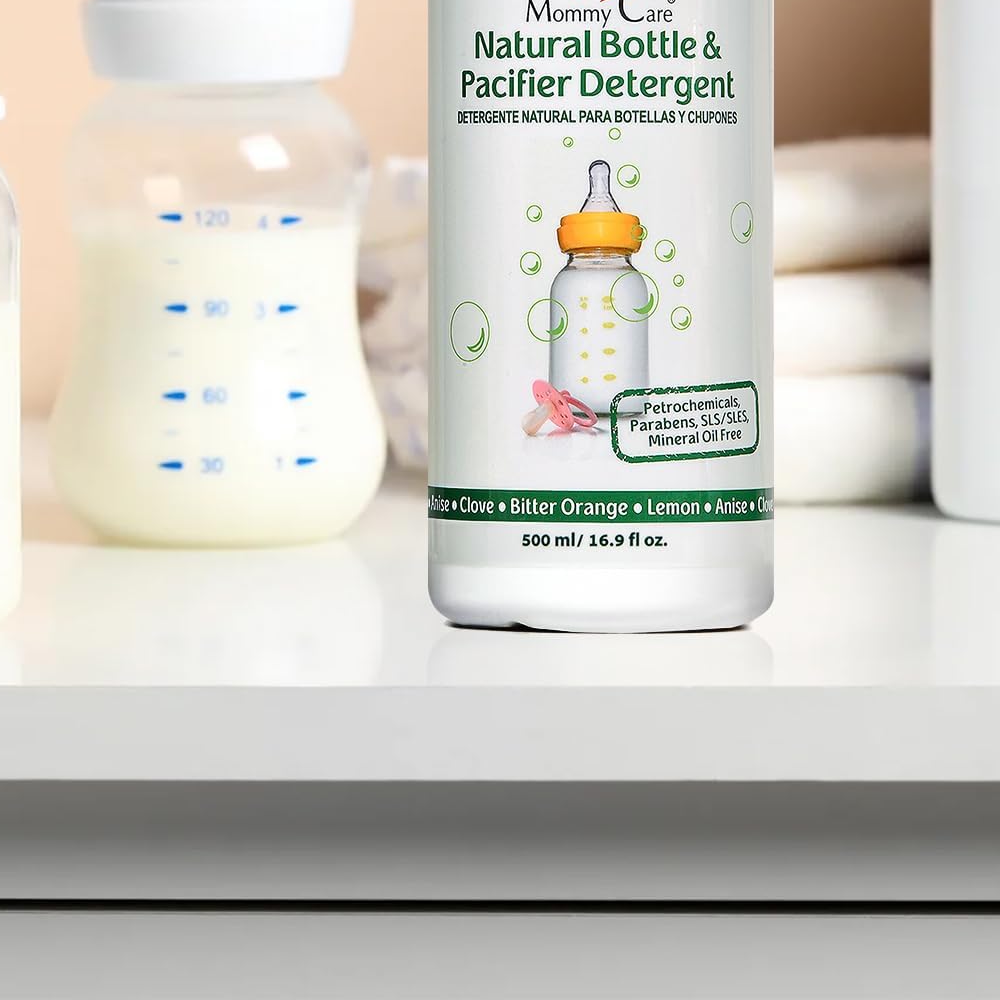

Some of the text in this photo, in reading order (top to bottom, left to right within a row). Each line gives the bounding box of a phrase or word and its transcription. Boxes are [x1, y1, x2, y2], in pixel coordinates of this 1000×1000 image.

[474, 30, 723, 60] Natural Bottle &
[461, 69, 736, 106] Pacifier Detergent
[457, 110, 738, 125] DETERGENTE NATURAL PARA BOTELLAS Y CHUPONES
[195, 209, 230, 227] 120
[203, 300, 230, 318] 90
[643, 395, 741, 415] Petrochemicals,
[630, 409, 750, 432] Parabens, SLS/SLES,
[648, 428, 742, 448] Mineral Oil Free
[199, 456, 225, 474] 30
[460, 496, 495, 514] Clove
[510, 497, 558, 516] Bitter
[560, 497, 629, 520] Orange
[647, 498, 700, 516] Lemon
[715, 497, 748, 515] Anise
[521, 533, 551, 547] 500
[588, 533, 625, 548] 16.9
[628, 531, 640, 547] fl
[643, 535, 668, 547] oz.
